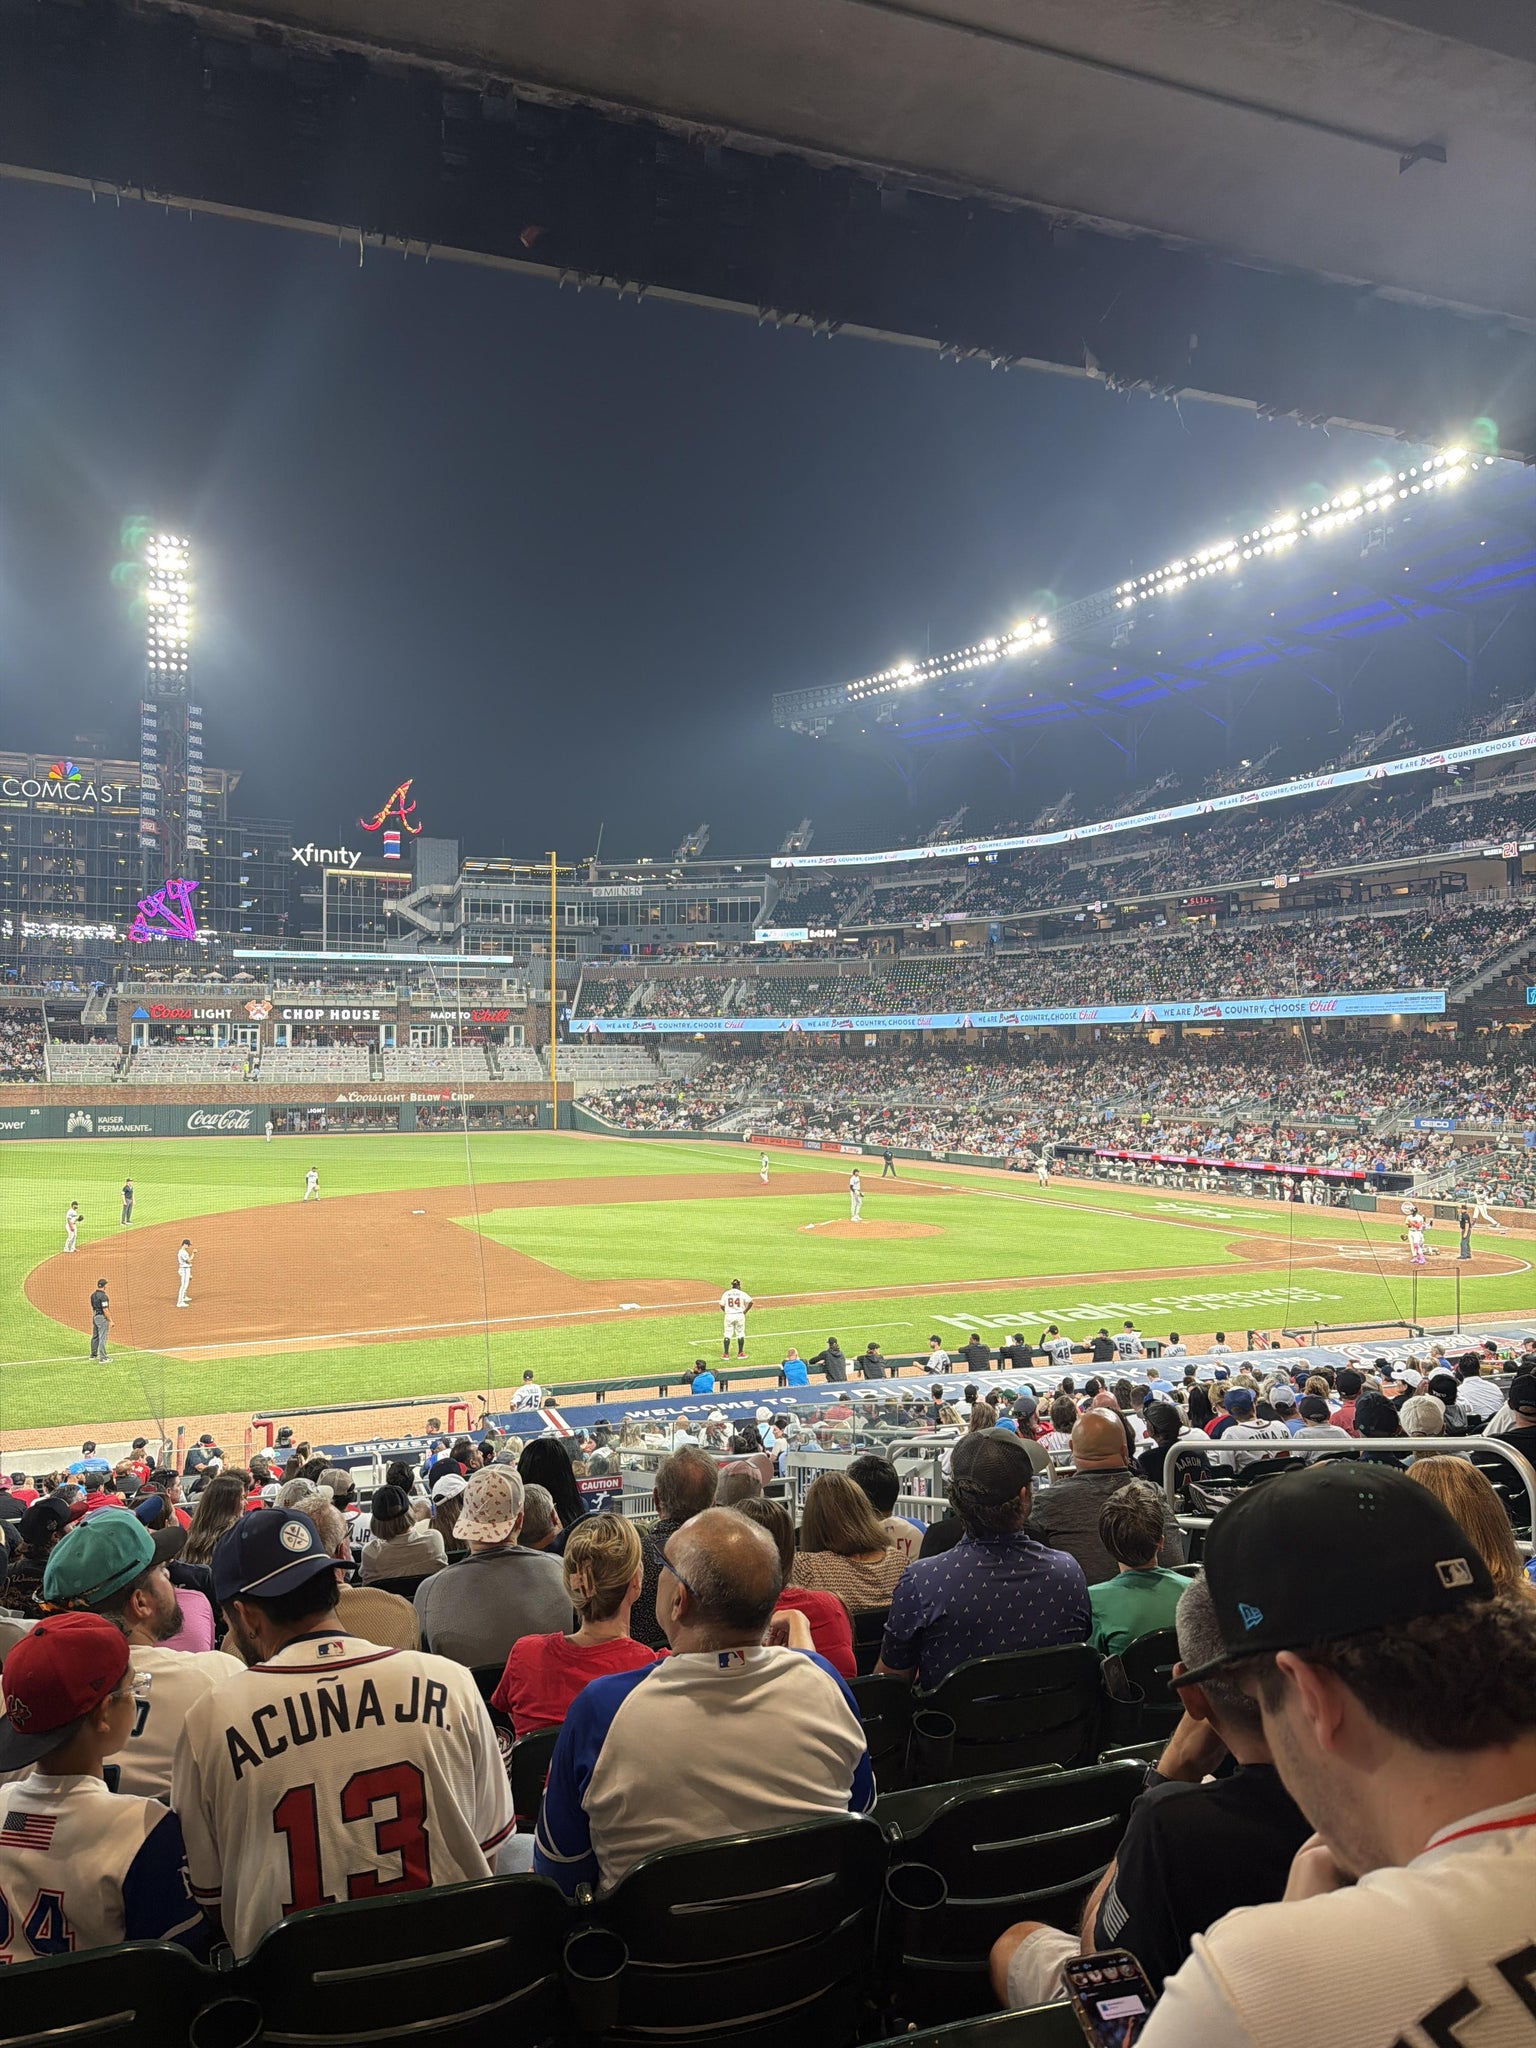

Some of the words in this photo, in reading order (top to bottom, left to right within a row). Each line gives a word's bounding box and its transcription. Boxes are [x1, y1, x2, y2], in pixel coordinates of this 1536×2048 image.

[2, 778, 126, 804] COMCAST
[291, 842, 362, 869] xfinity
[1502, 841, 1518, 858] 21
[1274, 874, 1288, 889] 10
[604, 886, 641, 896] MILNER
[824, 929, 837, 938] PM
[150, 1003, 193, 1019] Coors
[193, 1008, 233, 1019] LIGHT
[283, 1008, 325, 1020] CHOP
[330, 1008, 381, 1020] HOUSE
[1163, 1008, 1174, 1016] WE
[1176, 1007, 1191, 1016] ARE
[1224, 1004, 1267, 1015] COUNTRY,
[1268, 1003, 1306, 1013] CHOOSE
[1308, 999, 1339, 1012] Chill
[430, 1011, 457, 1020] MADE
[459, 1011, 471, 1020] TO
[471, 1009, 511, 1023] Chill
[888, 1018, 916, 1026] CHOOSE
[1050, 1012, 1077, 1021] CHOOSE
[1078, 1009, 1099, 1020] Chill
[724, 1020, 744, 1029] Chill
[348, 1091, 378, 1102] Coors
[378, 1094, 406, 1102] LIGHT
[98, 1116, 124, 1124] KAISER
[187, 1109, 255, 1130] Coca-Cola
[727, 1297, 741, 1308] 84
[1151, 1286, 1319, 1305] CHEROKEE
[1175, 1292, 1344, 1312] CASINOS
[1057, 1348, 1070, 1360] 48
[1119, 1342, 1132, 1354] 56
[820, 1379, 973, 1401] TRUIST
[1040, 1367, 1148, 1387] PARK
[526, 1395, 539, 1408] 45
[625, 1400, 757, 1418] WELCOME
[762, 1397, 798, 1406] TO
[1175, 1456, 1202, 1471] AARON
[581, 1479, 619, 1490] CAUTION
[355, 1528, 370, 1542] JR
[225, 1675, 386, 1782] ACUÑA
[394, 1676, 452, 1732] JR.
[272, 1760, 434, 1918] 13
[0, 1886, 75, 1965] 4
